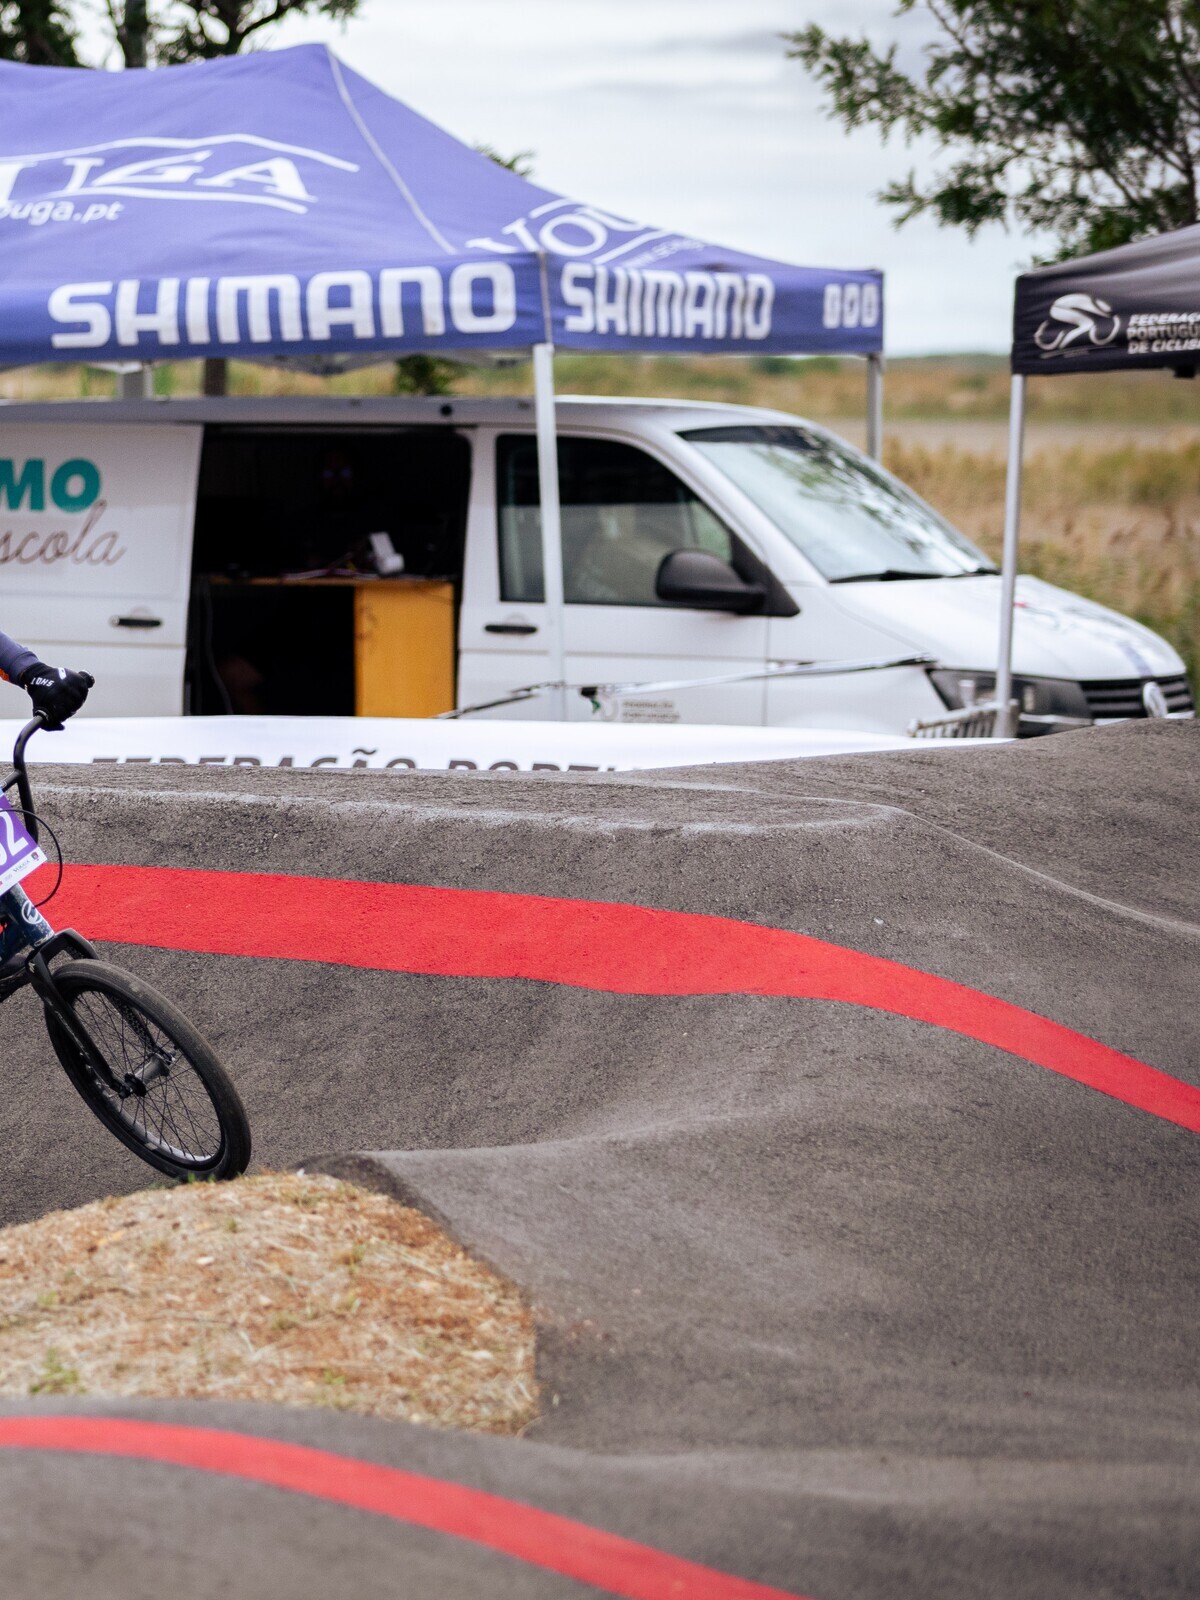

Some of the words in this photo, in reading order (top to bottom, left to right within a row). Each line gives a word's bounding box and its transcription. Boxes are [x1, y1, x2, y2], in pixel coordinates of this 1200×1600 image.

[47, 261, 517, 349] SHIMANO
[561, 262, 775, 341] SHIMANO
[1128, 312, 1200, 326] FEDERAÇ
[1127, 323, 1200, 340] PORTUGU
[1151, 338, 1200, 352] CICLIS
